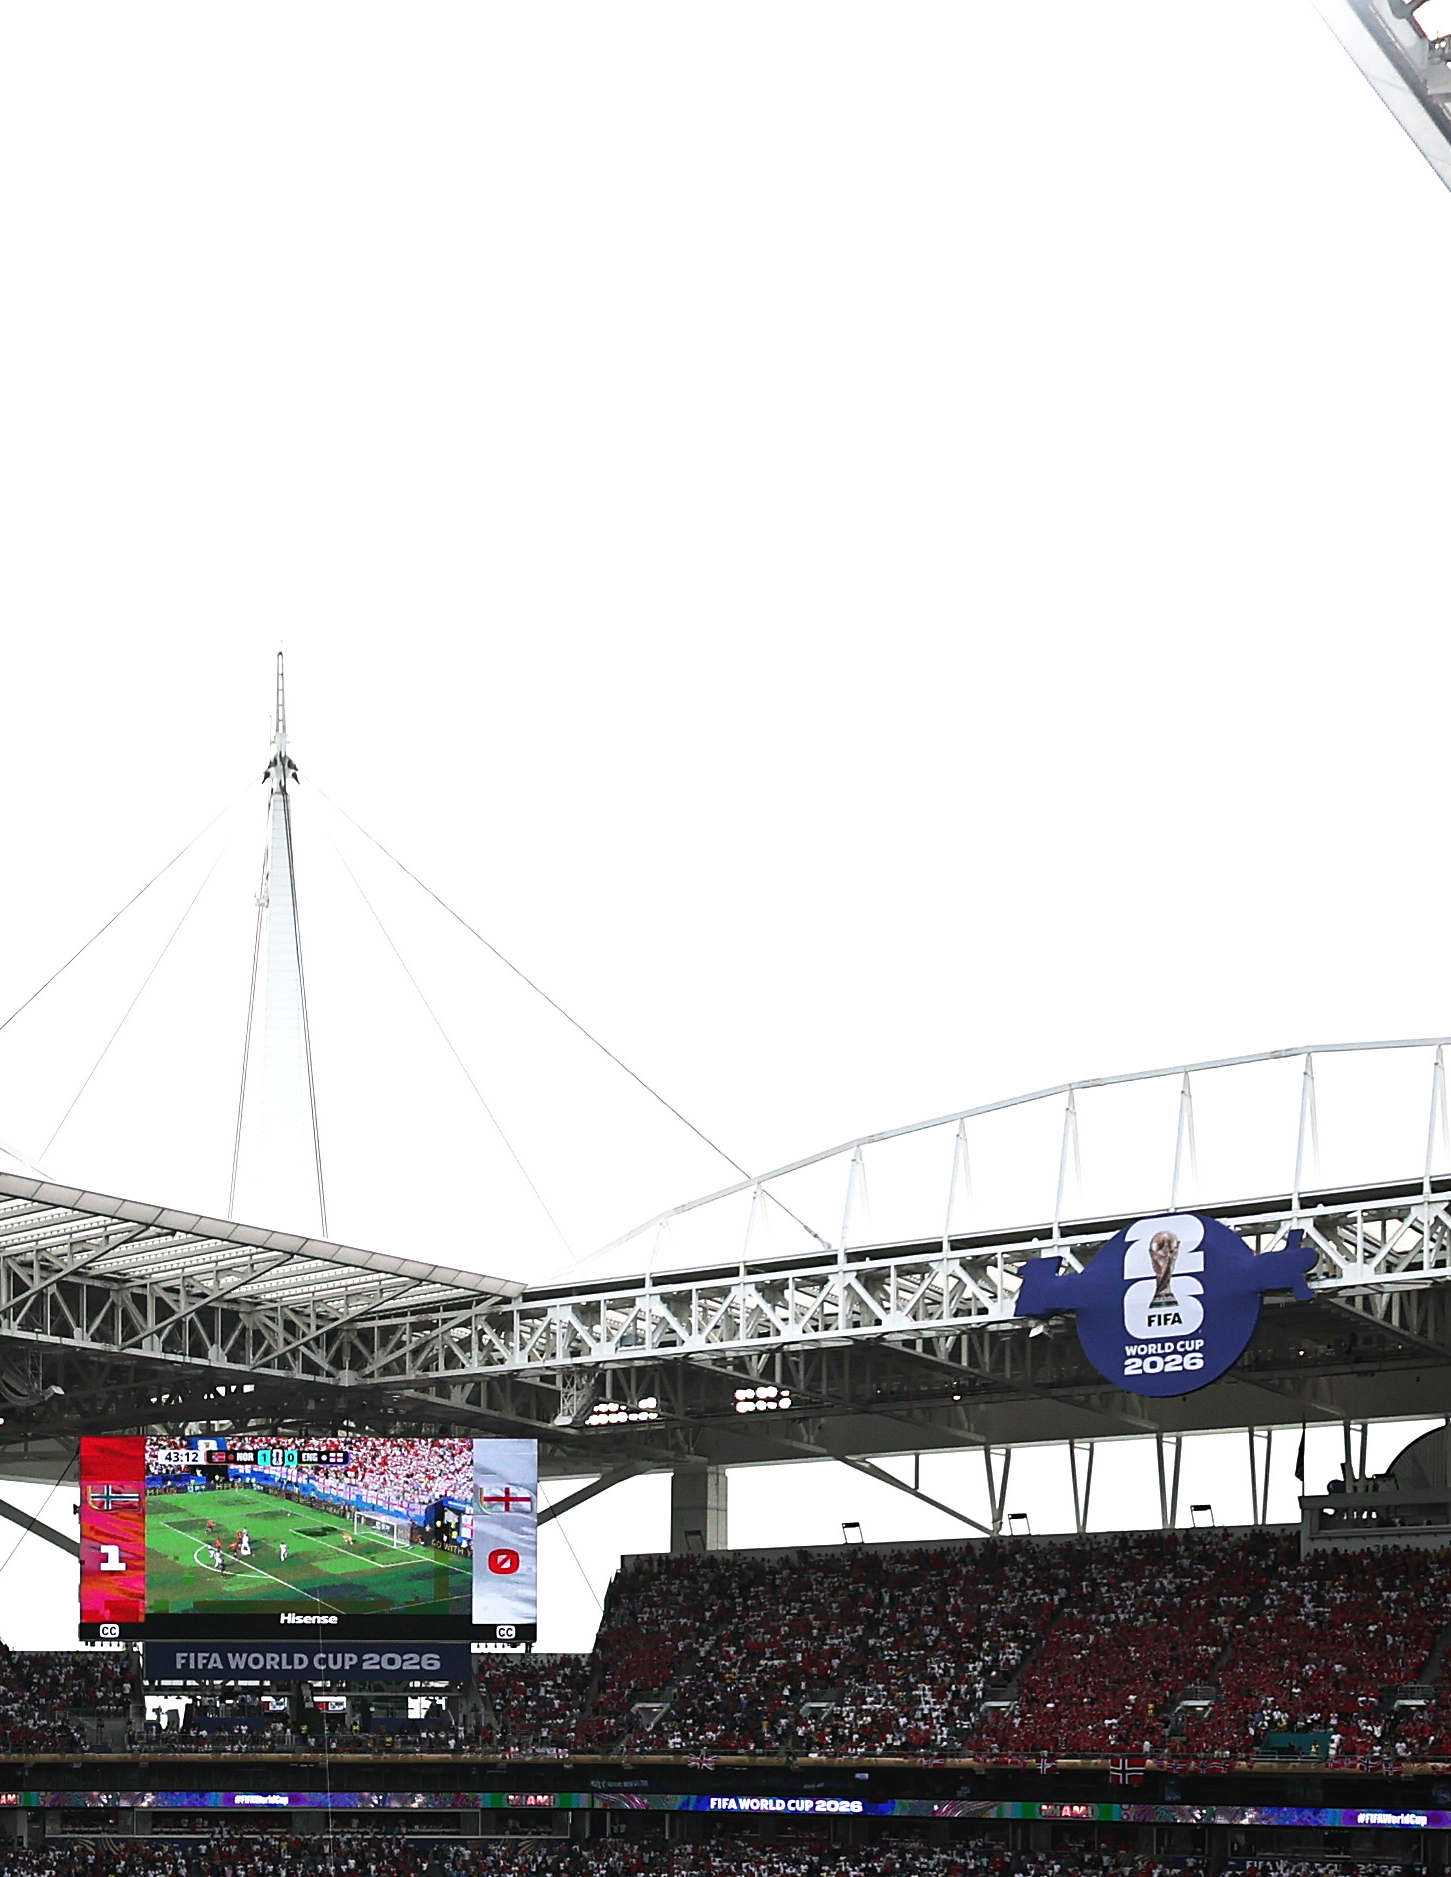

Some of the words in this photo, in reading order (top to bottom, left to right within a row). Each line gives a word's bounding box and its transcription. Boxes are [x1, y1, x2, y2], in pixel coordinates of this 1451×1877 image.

[1147, 1312, 1183, 1328] FIFA
[1125, 1342, 1174, 1357] WORLD
[1177, 1340, 1204, 1351] CUP
[1124, 1353, 1203, 1375] 2026
[164, 1451, 199, 1464] 43:12
[237, 1452, 254, 1461] NOR
[261, 1452, 268, 1464] 1
[287, 1452, 294, 1464] 0
[302, 1453, 318, 1461] ENG
[101, 1545, 125, 1570] 1
[280, 1613, 338, 1623] Hisense
[101, 1627, 117, 1637] CC
[498, 1628, 514, 1638] CC
[176, 1653, 223, 1669] FIFA
[228, 1653, 308, 1669] WORLD
[314, 1653, 357, 1670] CUP
[363, 1654, 440, 1670] 2026
[710, 1798, 737, 1809] FIFA
[739, 1799, 785, 1810] WORLD
[787, 1800, 813, 1811] CUP
[815, 1800, 862, 1812] 2026
[1358, 1813, 1427, 1826] #FIFAWorldCup
